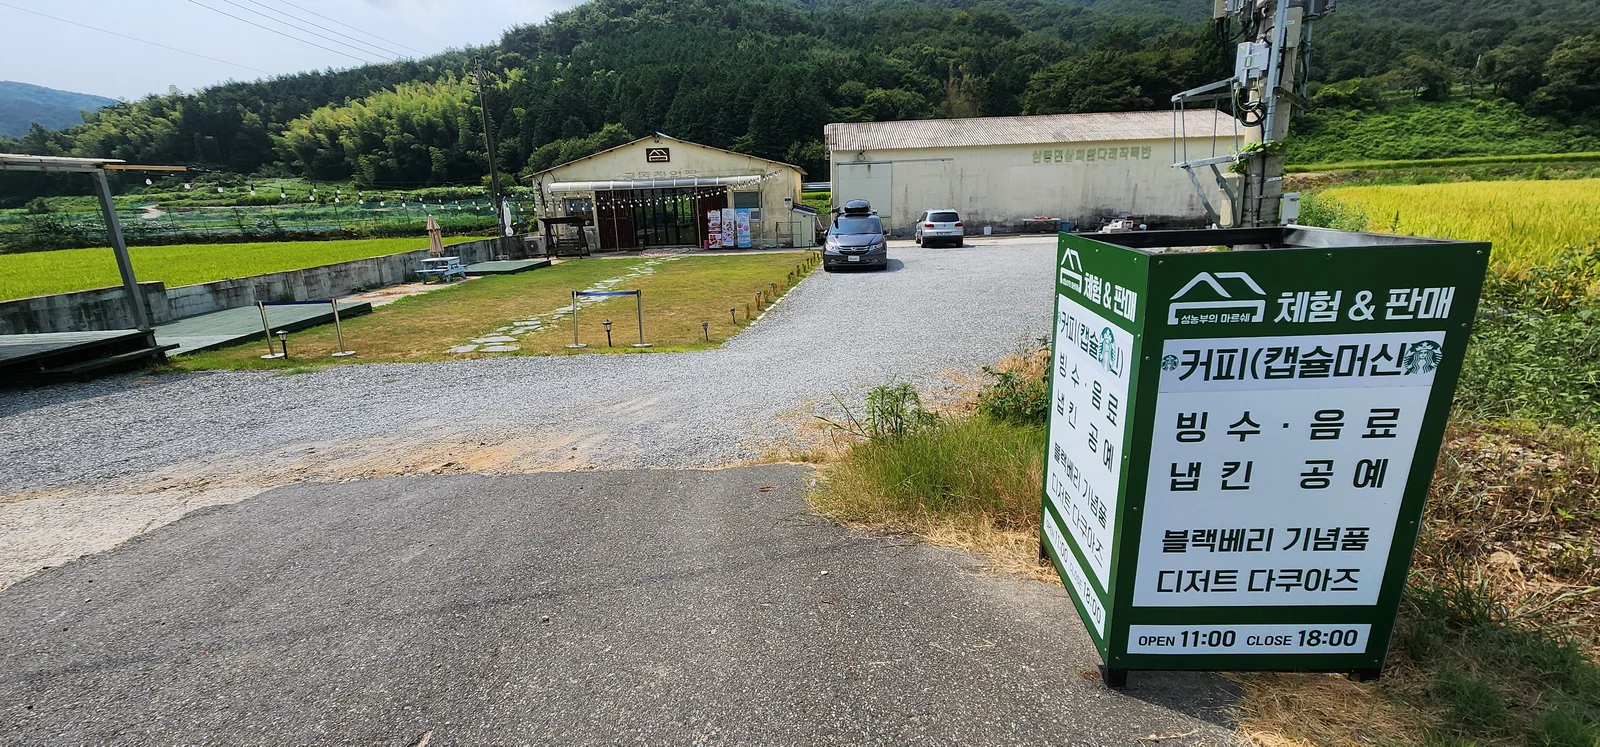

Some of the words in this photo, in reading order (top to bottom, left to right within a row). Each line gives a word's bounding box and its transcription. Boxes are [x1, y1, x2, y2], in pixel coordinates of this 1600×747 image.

[1083, 272, 1102, 304] 체험
[1103, 281, 1112, 309] &
[1113, 285, 1138, 323] 판매
[1273, 290, 1342, 323] 체험
[1348, 290, 1376, 321] &
[1385, 286, 1456, 321] 판매
[1053, 442, 1081, 492] 블랙베리
[1082, 478, 1108, 530] 기념품
[1051, 472, 1072, 516] 디저트
[1072, 503, 1104, 568] 다쿠아즈
[1162, 527, 1274, 553] 블랙베리
[1282, 526, 1370, 552] 기념품
[1156, 569, 1239, 593] 디저트
[1247, 567, 1361, 593] 다쿠아즈
[1083, 582, 1102, 625] 18:00
[1138, 635, 1175, 647] OPEN
[1180, 630, 1236, 648] 11:00
[1246, 635, 1293, 646] CLOSE
[1298, 629, 1359, 647] 18:00
